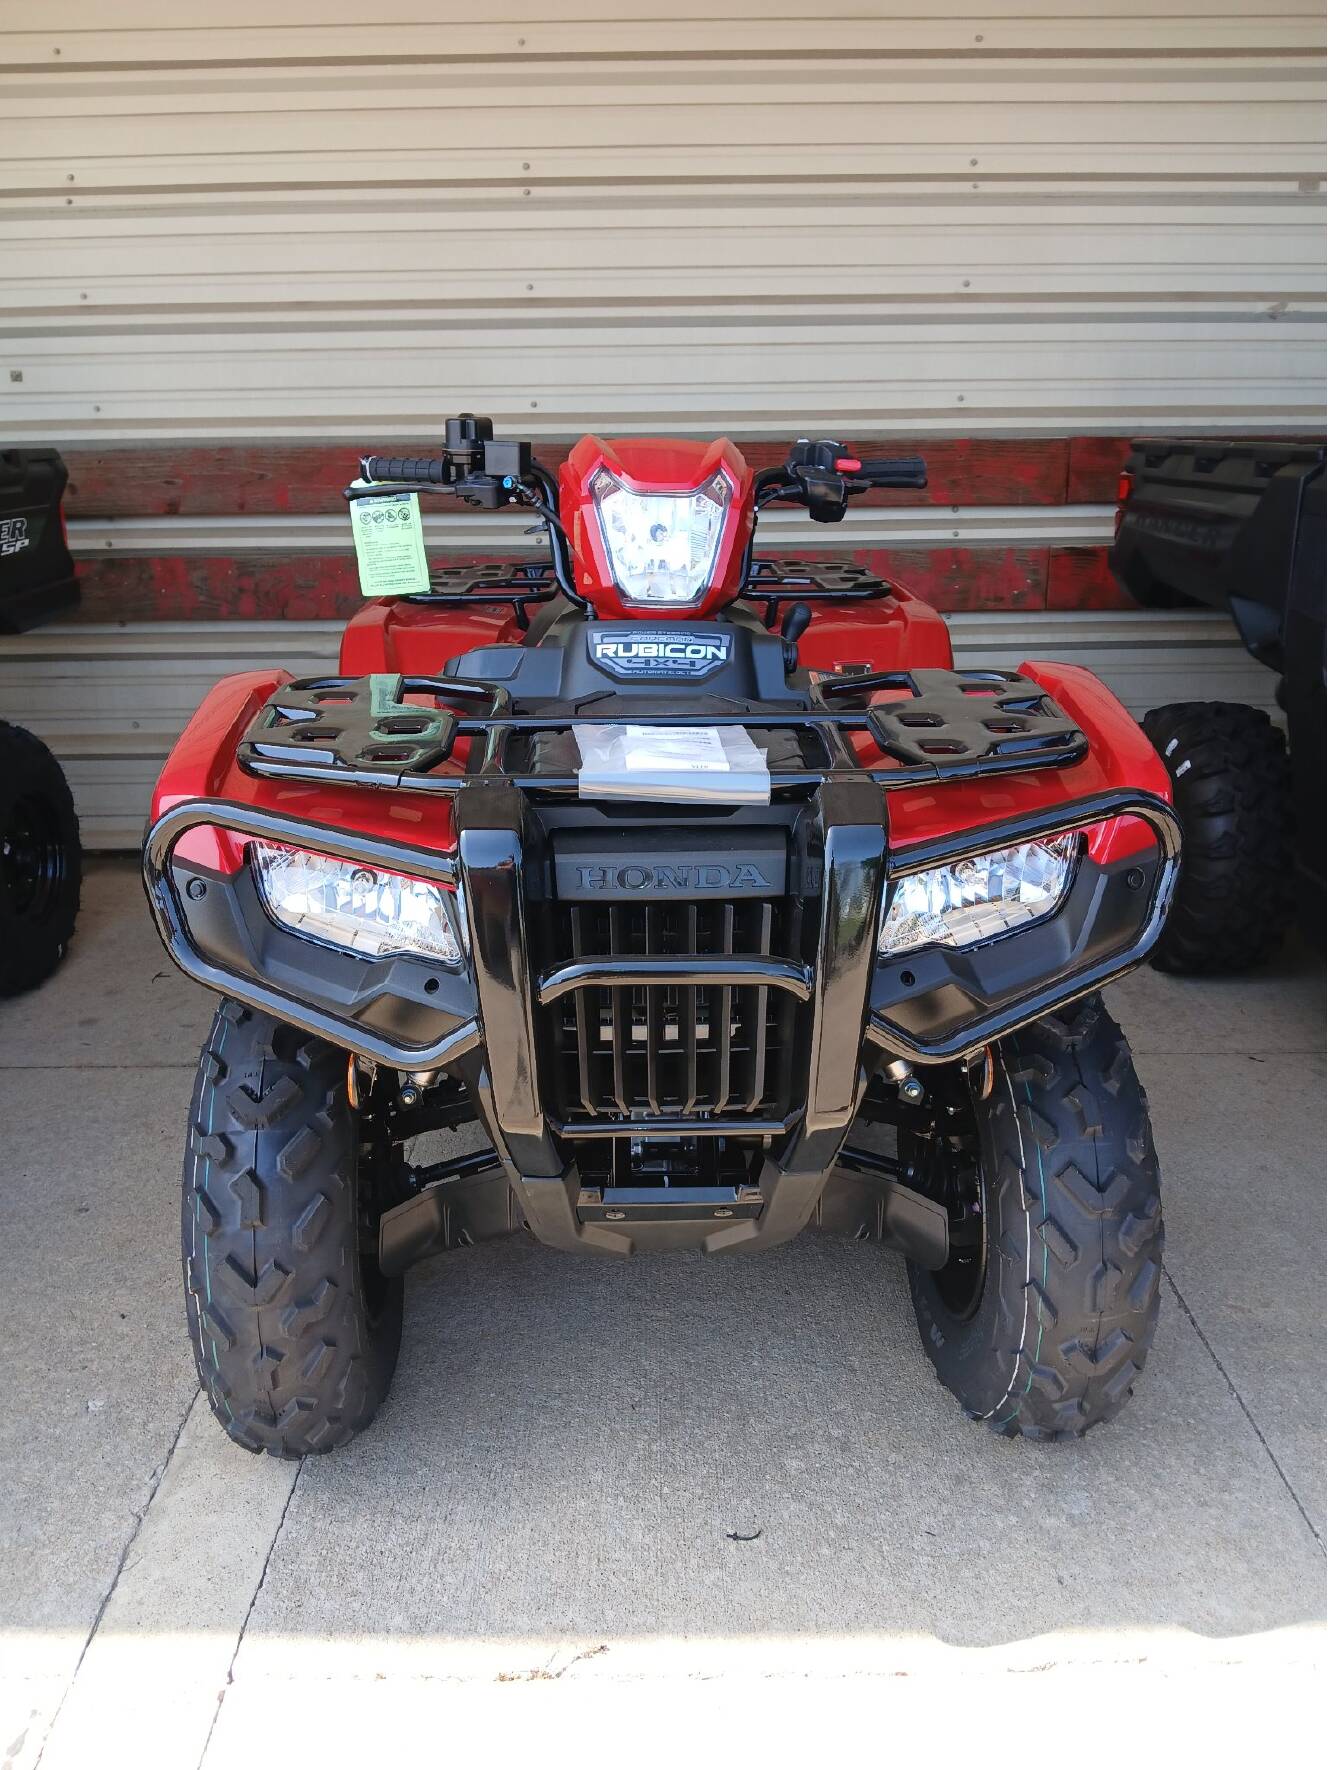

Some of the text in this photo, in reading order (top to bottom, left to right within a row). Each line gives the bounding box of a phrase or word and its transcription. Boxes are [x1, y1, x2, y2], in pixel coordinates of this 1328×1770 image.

[1, 538, 29, 556] SP
[595, 643, 727, 660] RUBICON
[626, 659, 696, 668] 4X4
[575, 863, 773, 890] HONDA
